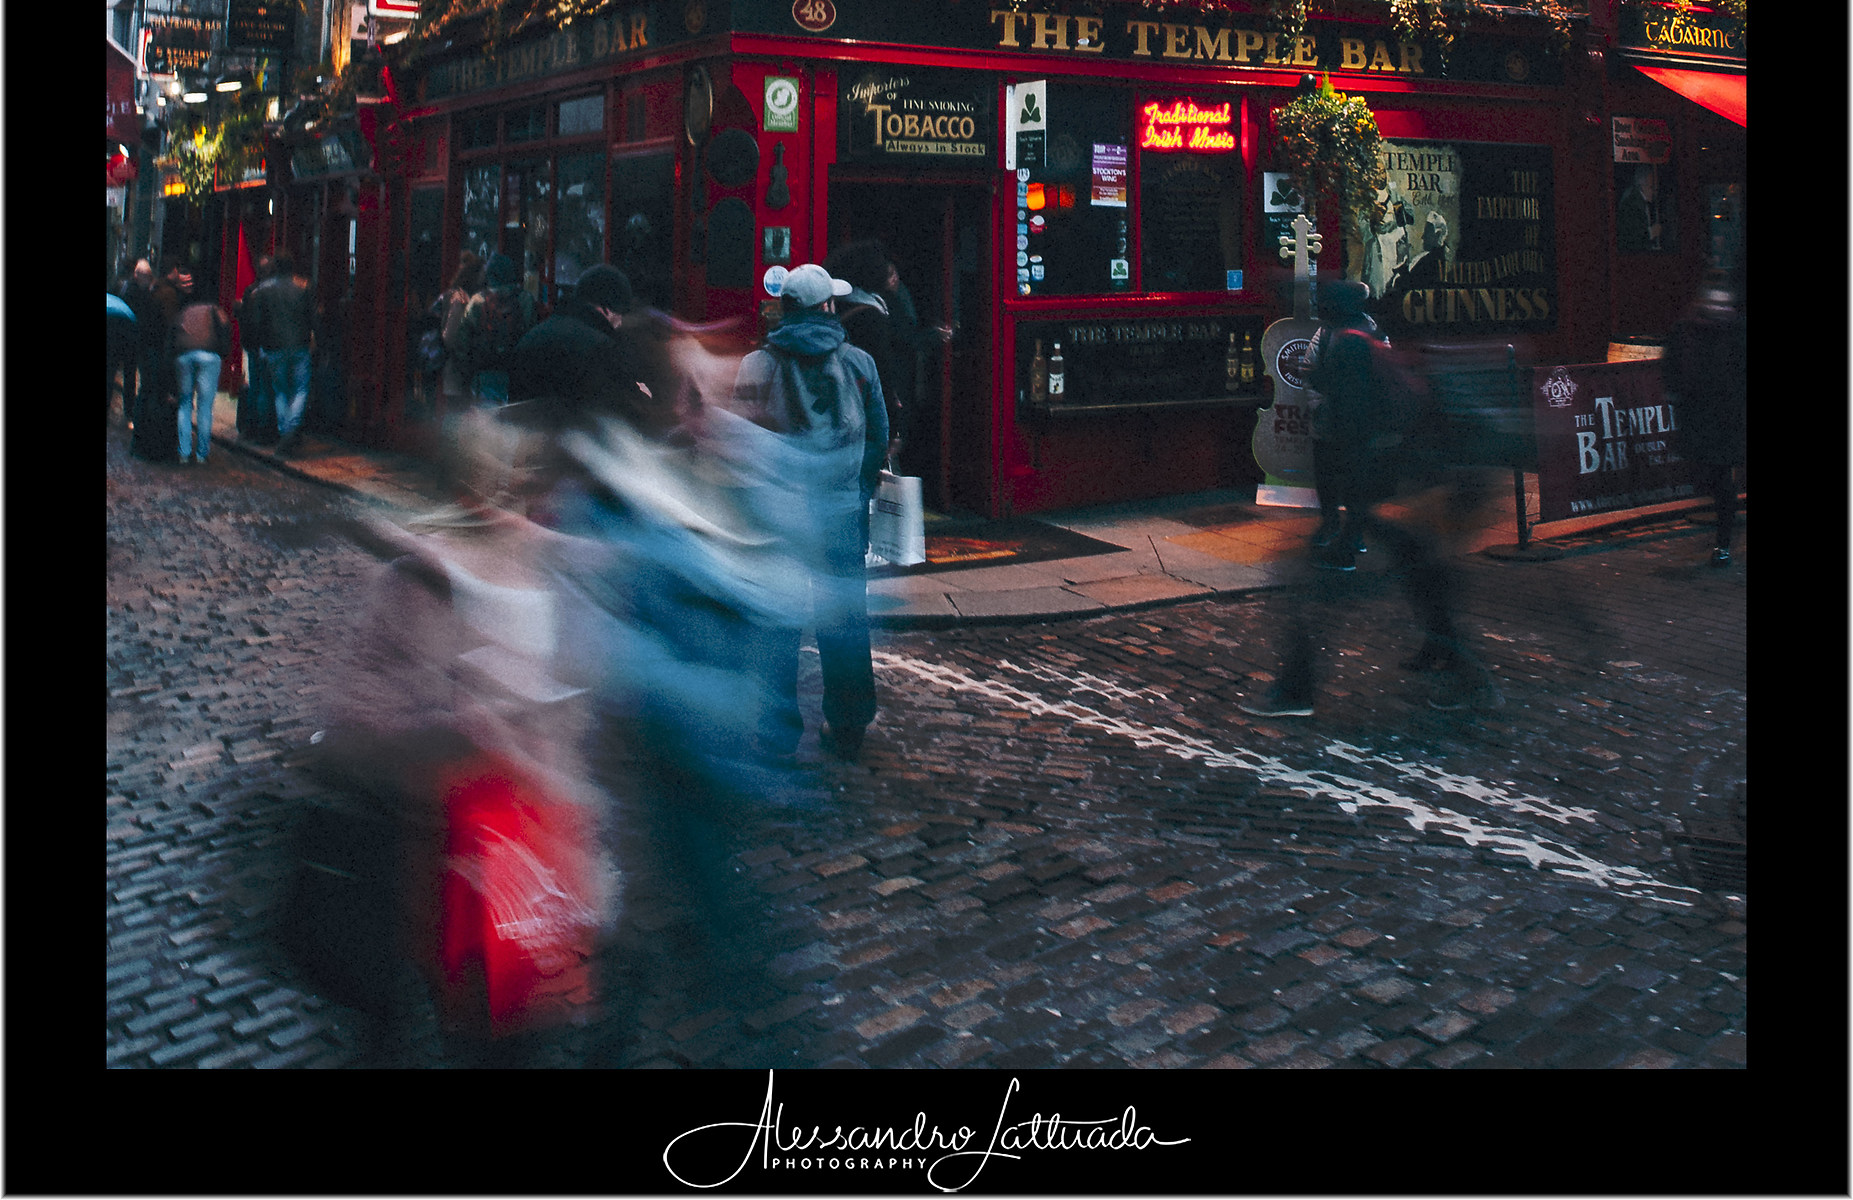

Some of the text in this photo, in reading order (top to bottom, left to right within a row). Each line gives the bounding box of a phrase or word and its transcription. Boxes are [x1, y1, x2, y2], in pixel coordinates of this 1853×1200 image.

[800, 0, 827, 22] 48
[592, 11, 649, 57] BAR
[990, 10, 1424, 73] THE TEMPLE BAR
[847, 77, 910, 105] Importers
[903, 99, 975, 112] FINE SMOKING
[1144, 102, 1231, 124] Traditional
[865, 103, 975, 146] TOBACCO
[886, 140, 986, 156] Always in Stock
[1142, 124, 1235, 149] Irish Music
[1384, 152, 1457, 173] TEMPLE
[1407, 173, 1443, 193] BAR
[1512, 170, 1540, 193] THE
[1477, 197, 1540, 220] EMPEROR
[1437, 259, 1492, 284] MALTED
[1402, 288, 1551, 323] GUINNESS
[1069, 324, 1108, 344] THE
[1111, 323, 1183, 343] TEMPLE
[1284, 371, 1303, 385] IRIS
[1574, 413, 1595, 428] THE
[1576, 431, 1628, 475] BAR
